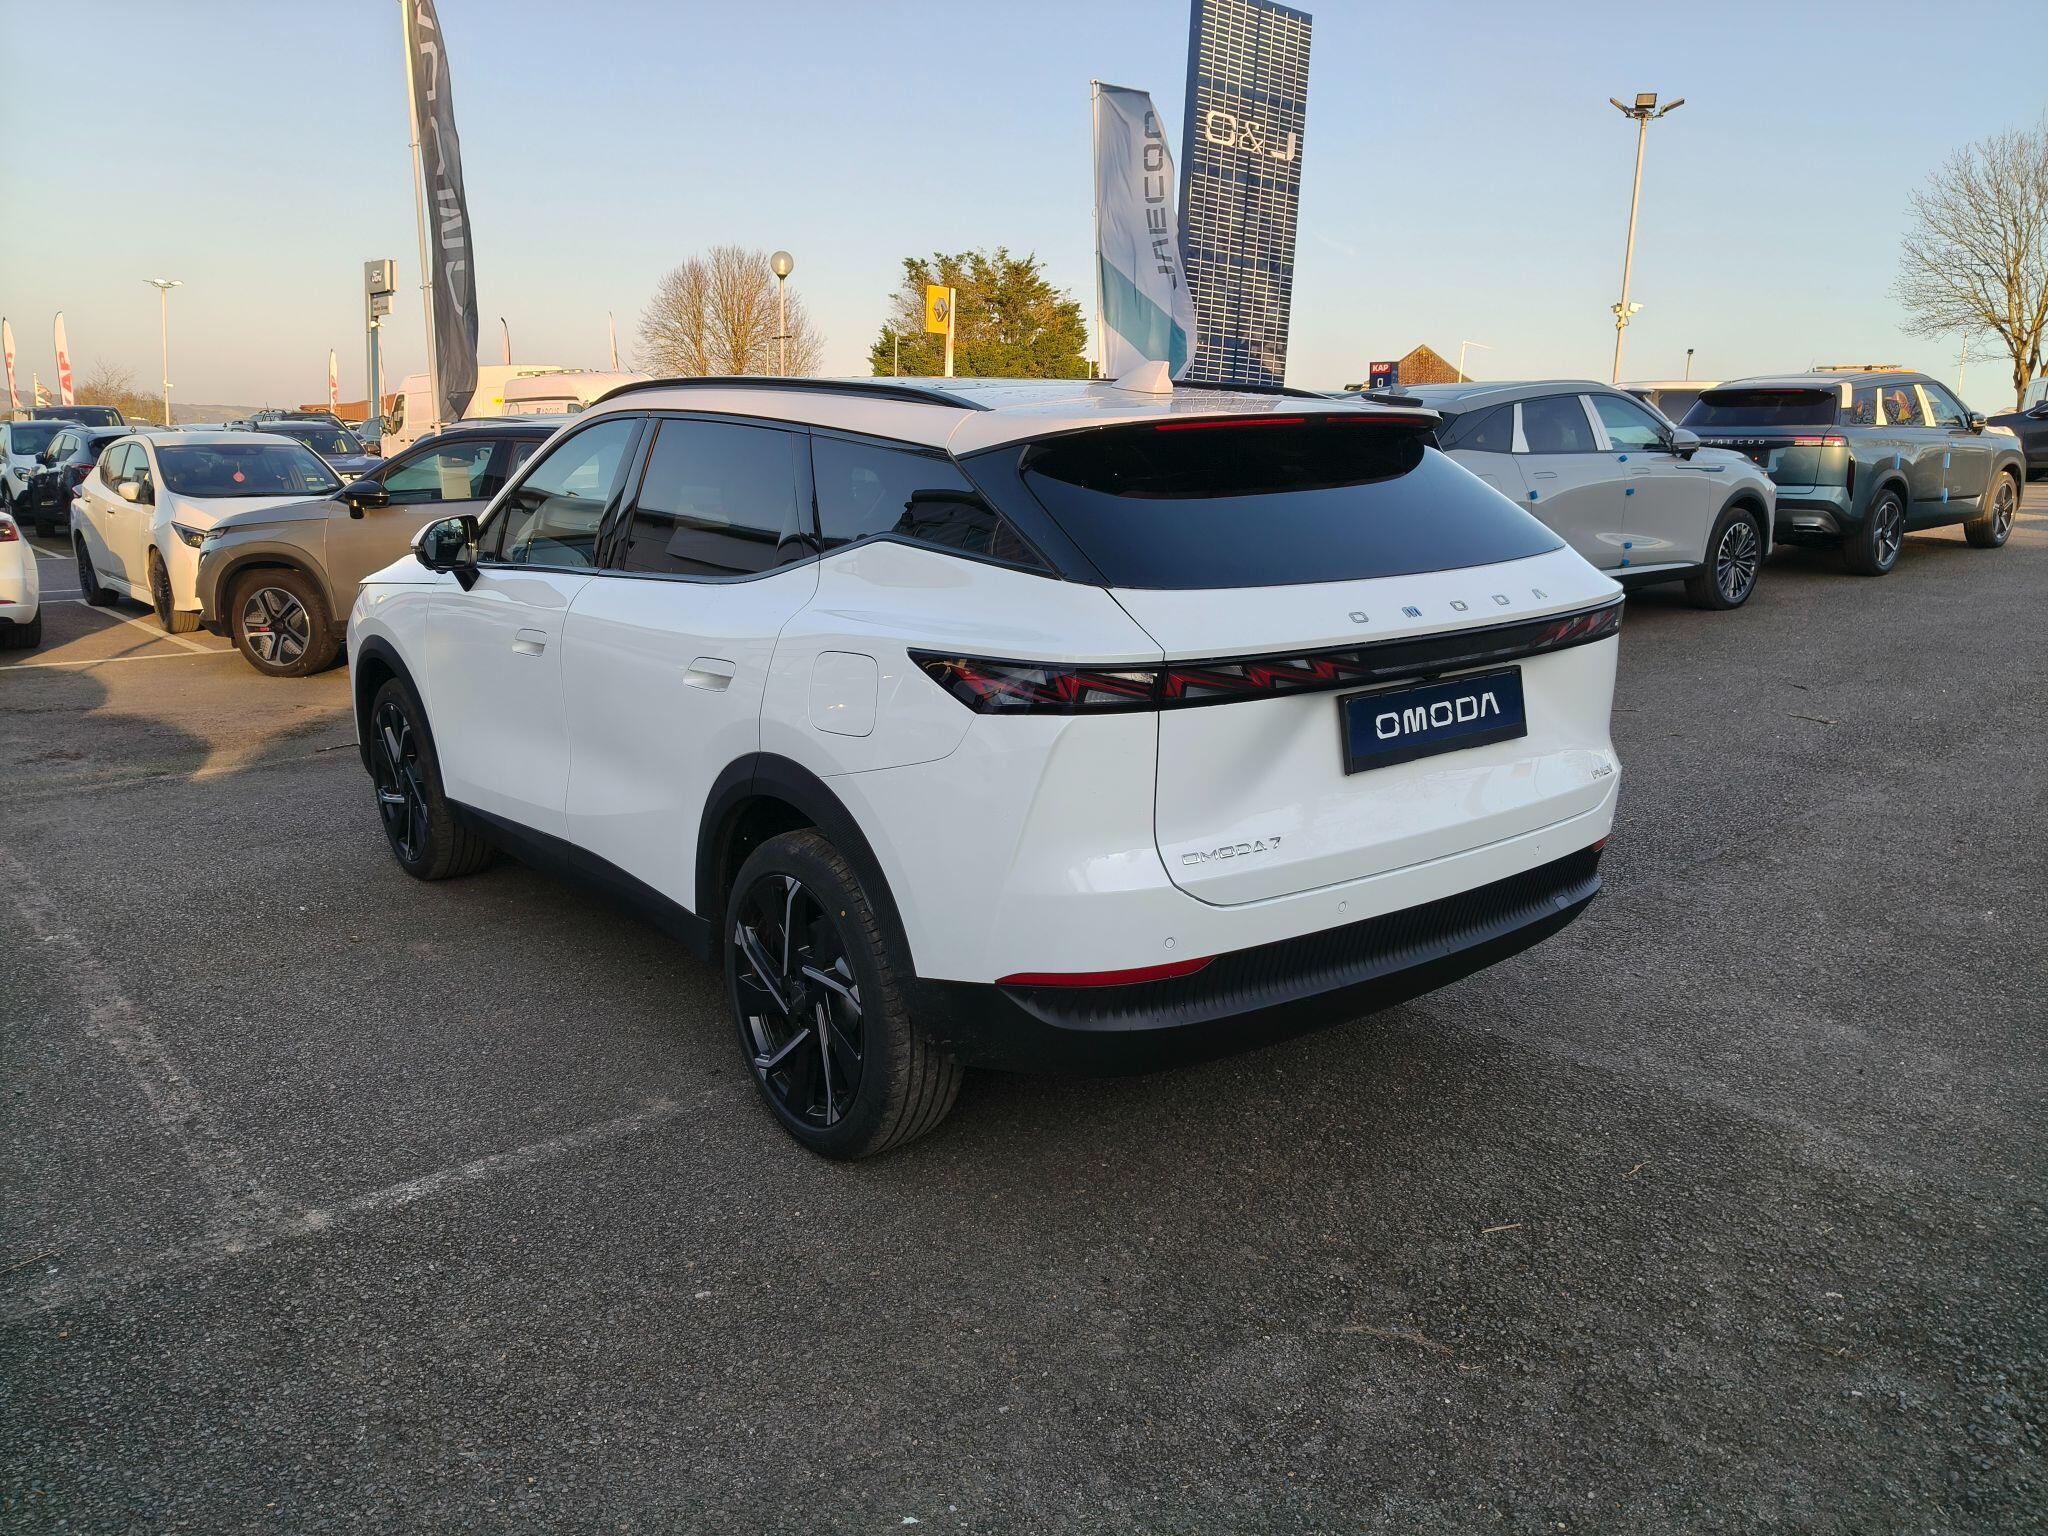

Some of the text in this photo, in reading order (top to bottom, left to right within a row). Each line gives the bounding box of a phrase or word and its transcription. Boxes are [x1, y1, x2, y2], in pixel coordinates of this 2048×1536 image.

[1143, 110, 1178, 290] JAECOO
[1372, 364, 1389, 372] KAP
[1348, 588, 1548, 624] OMODA
[1375, 691, 1500, 740] OMODA
[1181, 836, 1282, 866] OMODA 7
